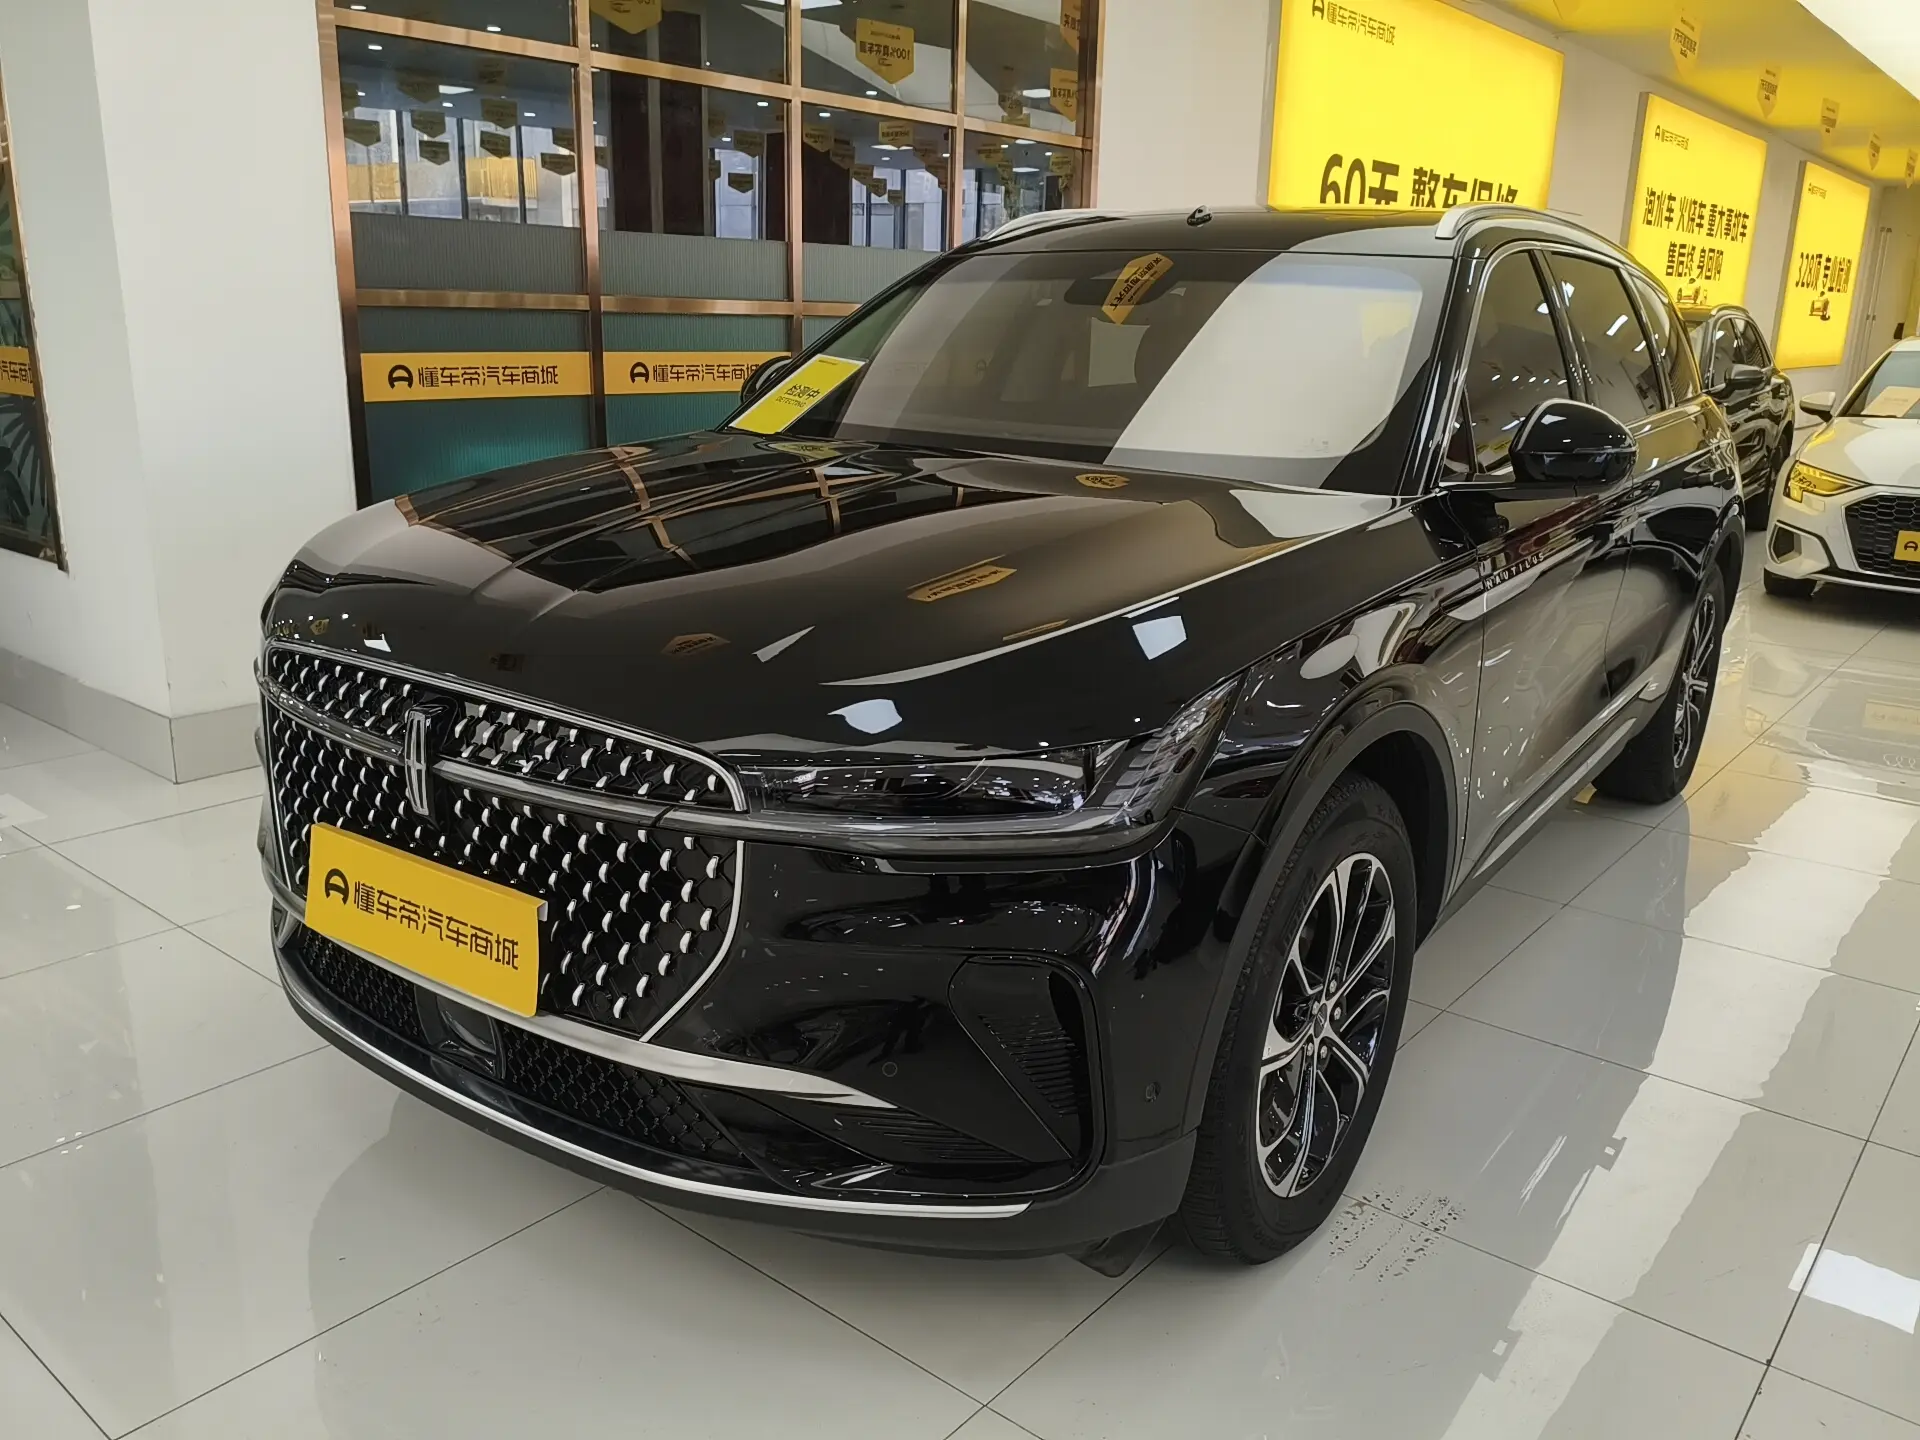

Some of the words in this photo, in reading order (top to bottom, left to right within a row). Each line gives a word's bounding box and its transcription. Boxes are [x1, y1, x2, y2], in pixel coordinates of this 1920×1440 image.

[1327, 1, 1396, 45] 懂车帝汽车商城
[1642, 187, 1676, 229] 泡水车
[1676, 195, 1706, 235] 火烧车
[1706, 203, 1750, 243] 重大事故车
[418, 365, 559, 388] 懂车帝汽车商城
[784, 384, 821, 400] 检测中
[776, 395, 807, 407] DETECTING
[1486, 552, 1545, 590] NAUTILUS
[353, 880, 520, 970] 懂车帝汽车商城
